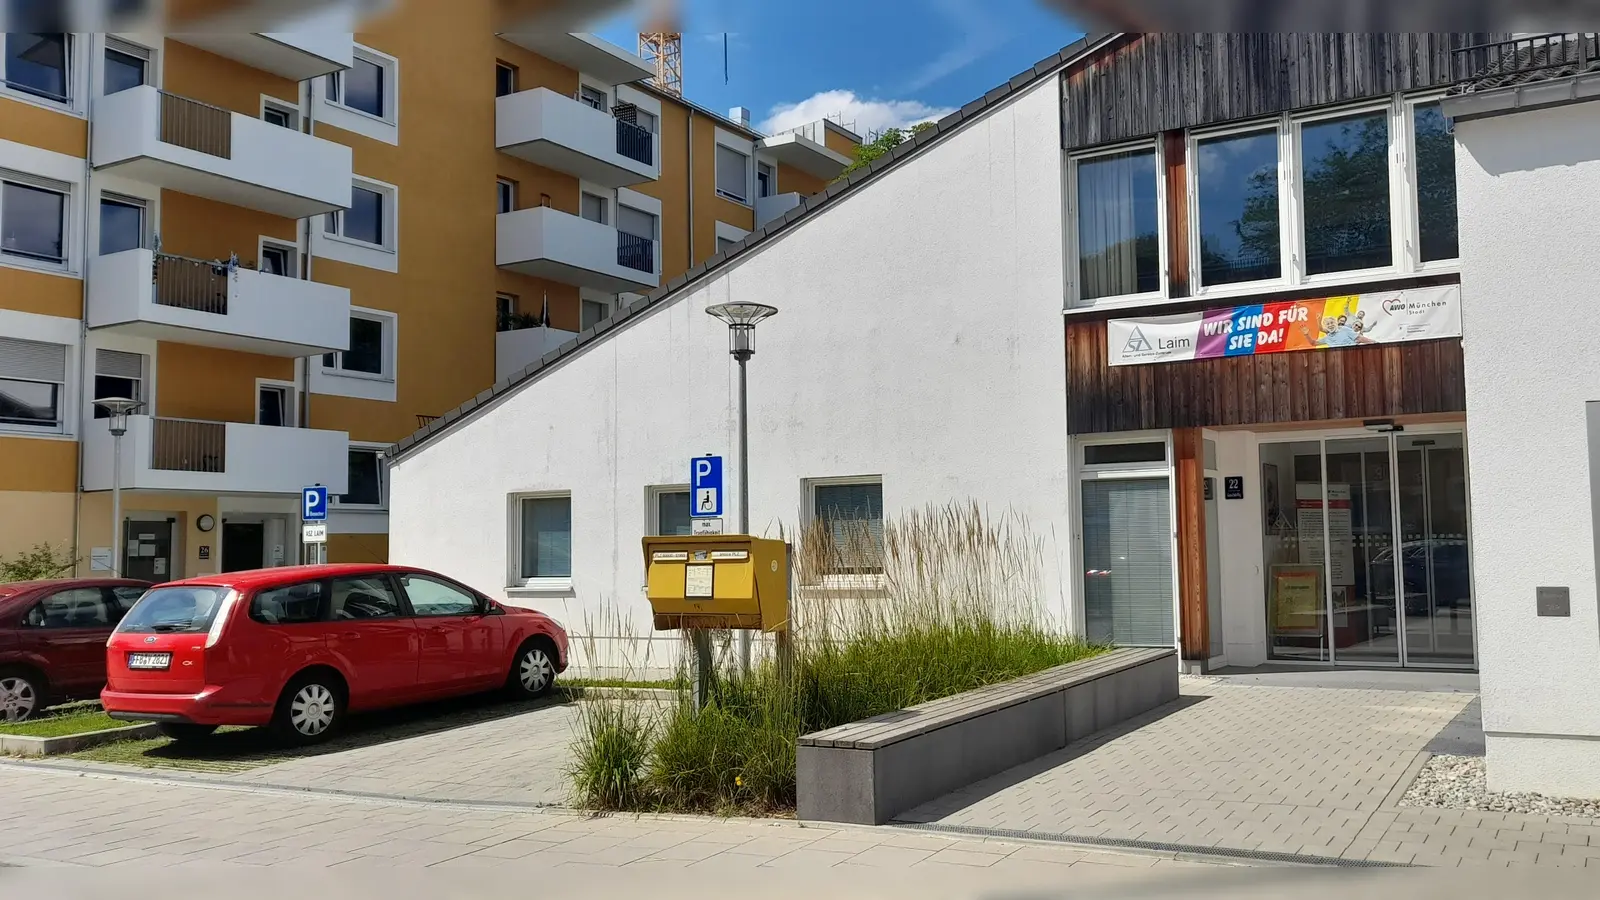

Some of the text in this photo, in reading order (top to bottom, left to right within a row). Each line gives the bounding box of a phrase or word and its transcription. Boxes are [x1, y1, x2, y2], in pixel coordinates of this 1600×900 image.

[1389, 301, 1447, 311] AWO München
[1203, 304, 1308, 337] WIR SIND FÜR
[1158, 336, 1190, 350] Laim
[1228, 328, 1285, 350] SIE DA!
[696, 459, 712, 487] P
[1229, 478, 1239, 489] 22
[305, 490, 320, 517] P
